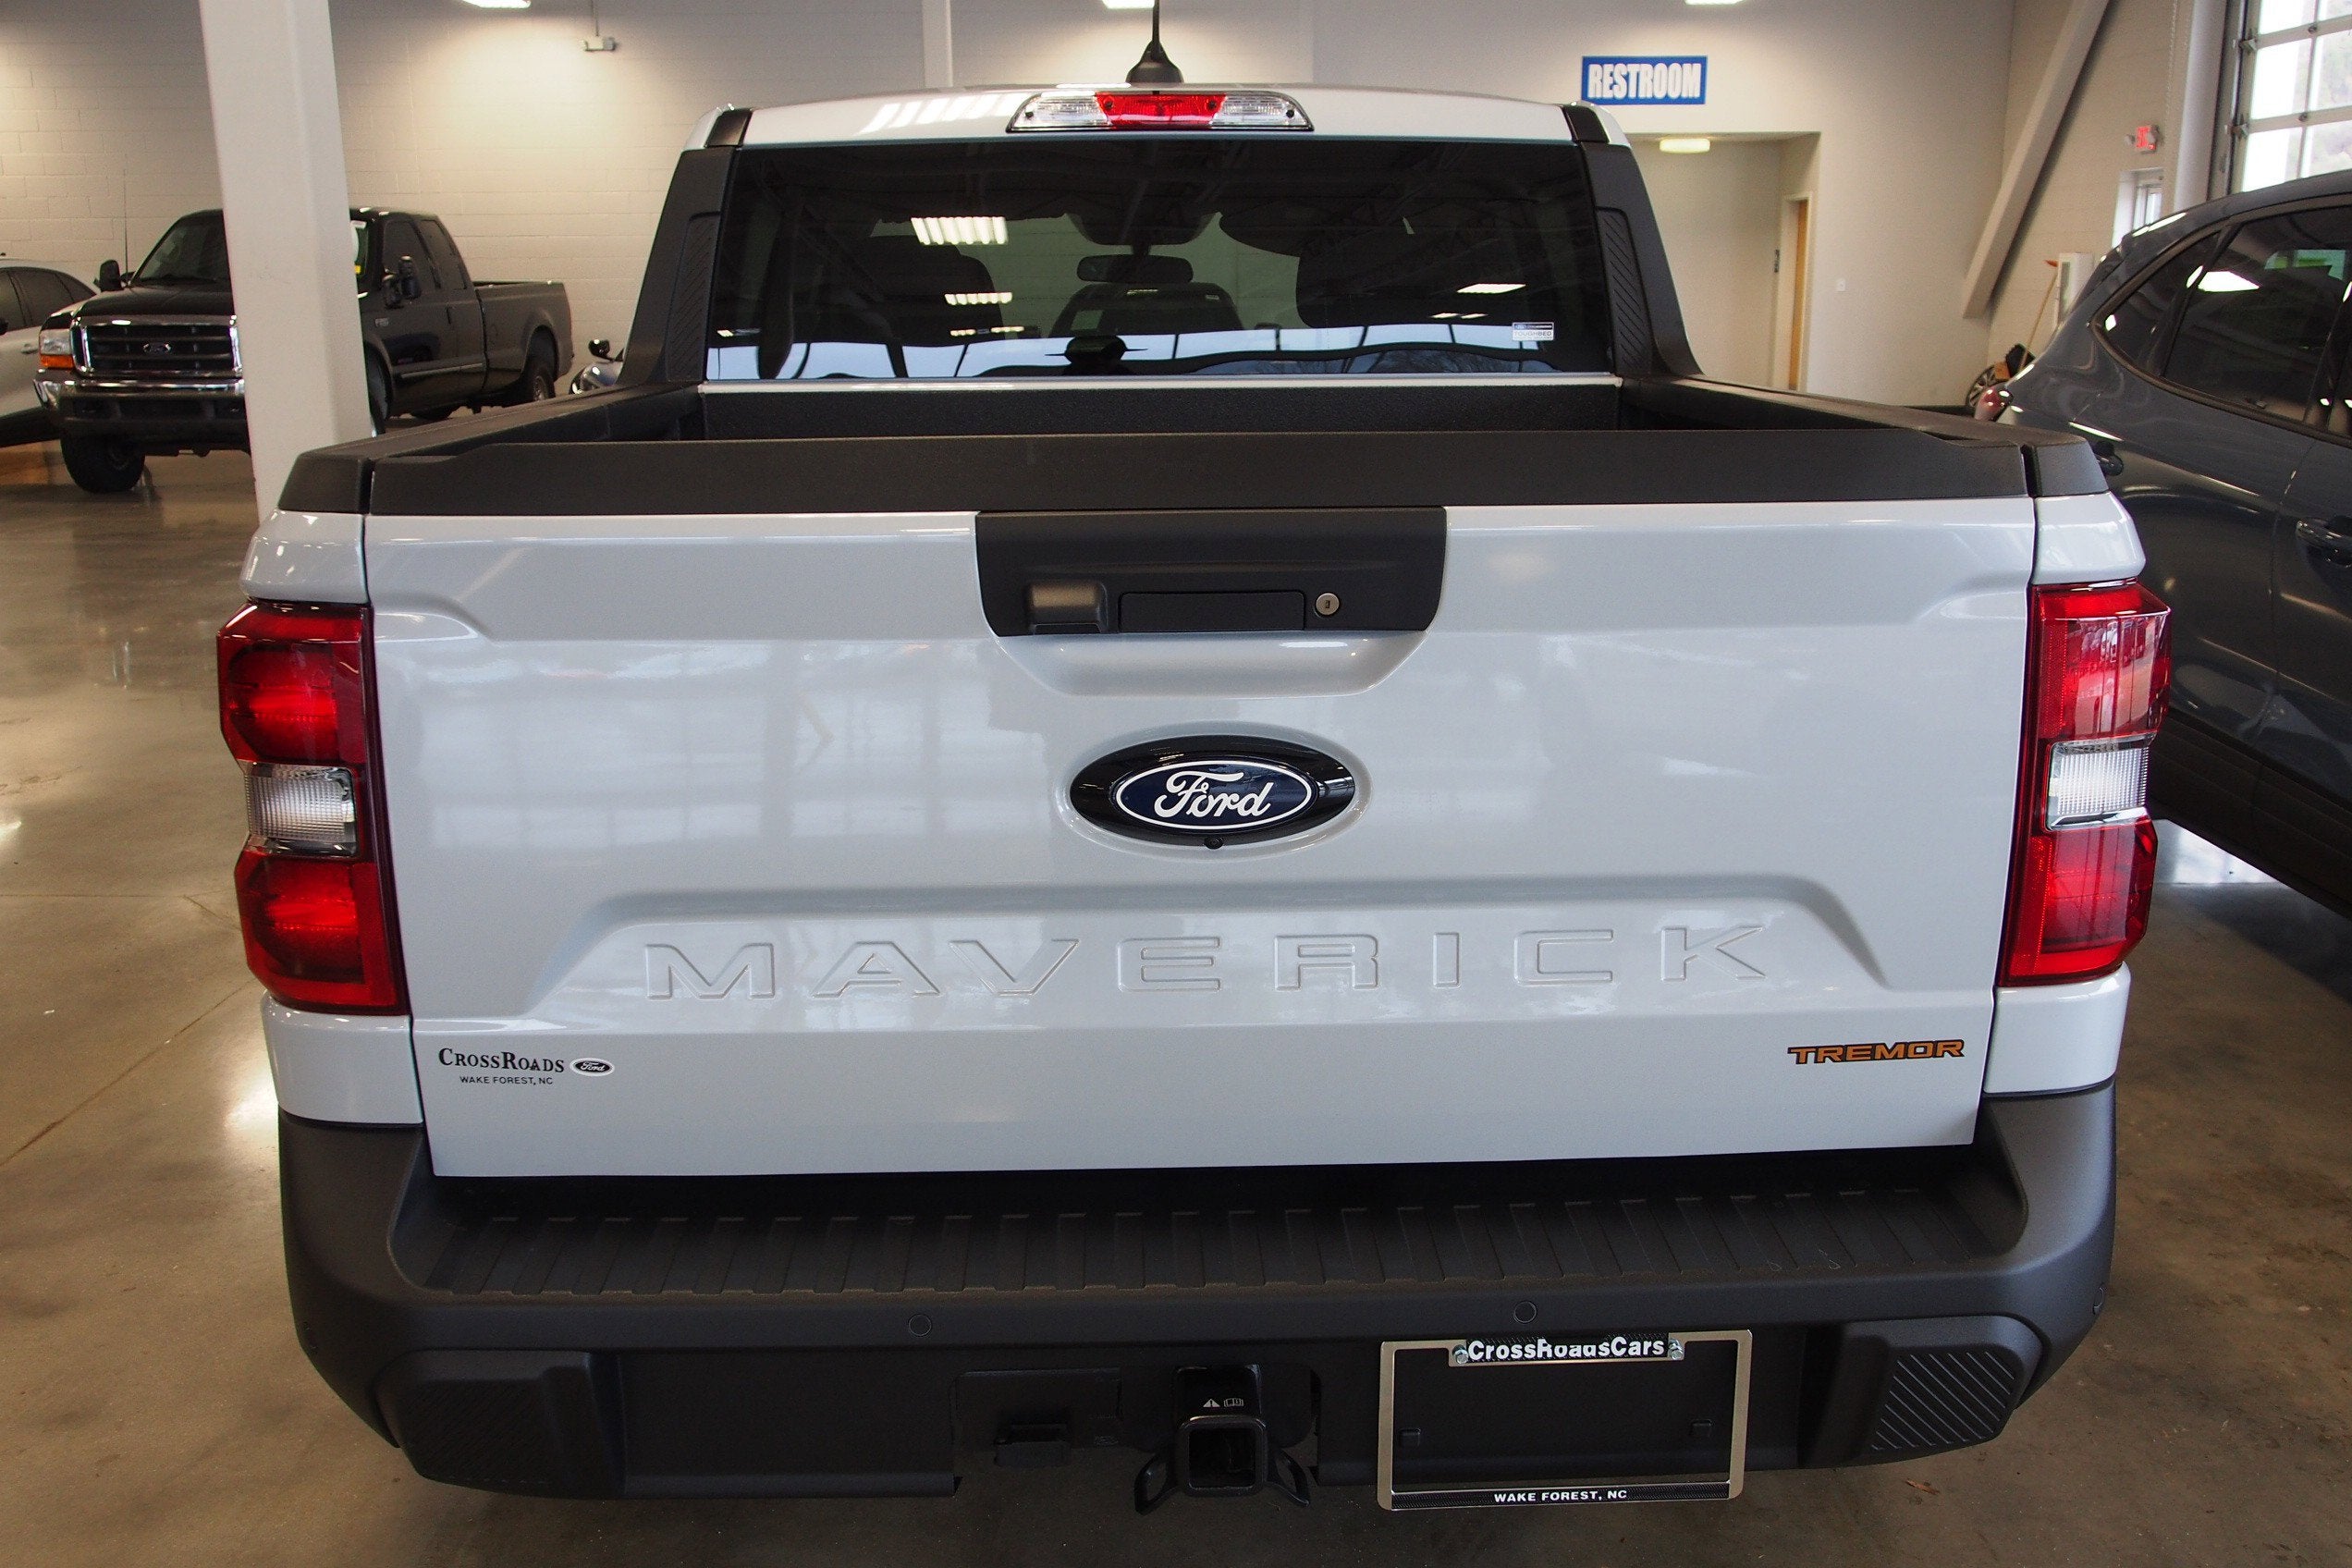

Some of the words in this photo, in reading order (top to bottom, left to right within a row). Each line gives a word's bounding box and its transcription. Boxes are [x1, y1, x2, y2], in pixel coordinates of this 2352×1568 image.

[1587, 62, 1701, 99] RESTROOM
[1155, 770, 1275, 818] Ford
[645, 925, 1767, 999] MAVERICK
[1787, 1039, 1965, 1064] TREMOR
[459, 1076, 490, 1084] WAKE
[493, 1076, 536, 1085] FOREST,
[1494, 1492, 1537, 1502] WAKE
[1541, 1490, 1602, 1501] FOREST,
[1607, 1489, 1628, 1500] NC
